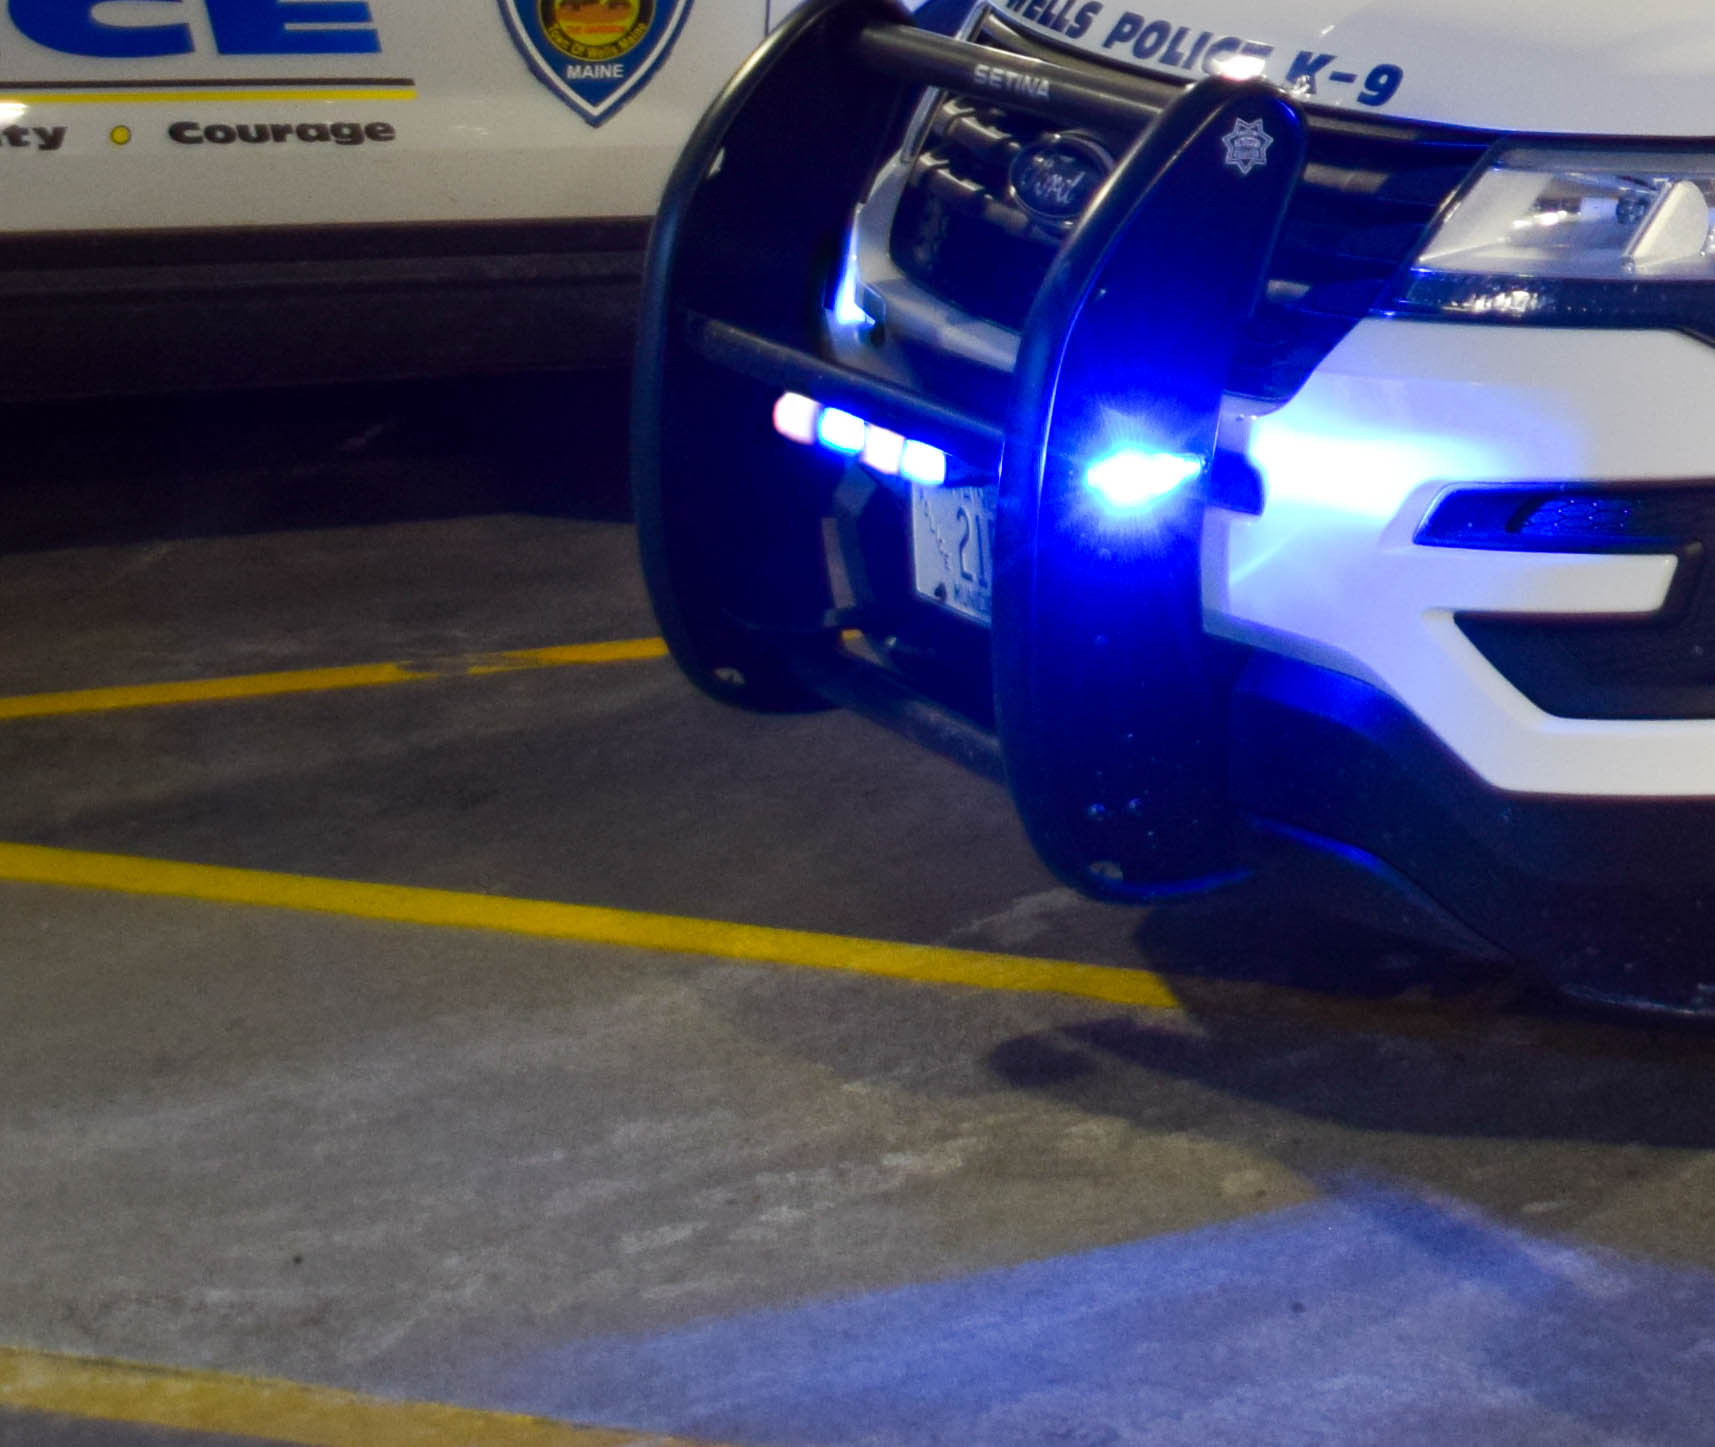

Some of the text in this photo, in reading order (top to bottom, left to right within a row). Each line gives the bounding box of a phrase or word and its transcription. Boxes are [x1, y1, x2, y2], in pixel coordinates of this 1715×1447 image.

[566, 64, 625, 80] MAINE
[972, 63, 1050, 102] SETINA
[1285, 51, 1405, 107] K-9
[0, 120, 397, 151] ty Courage
